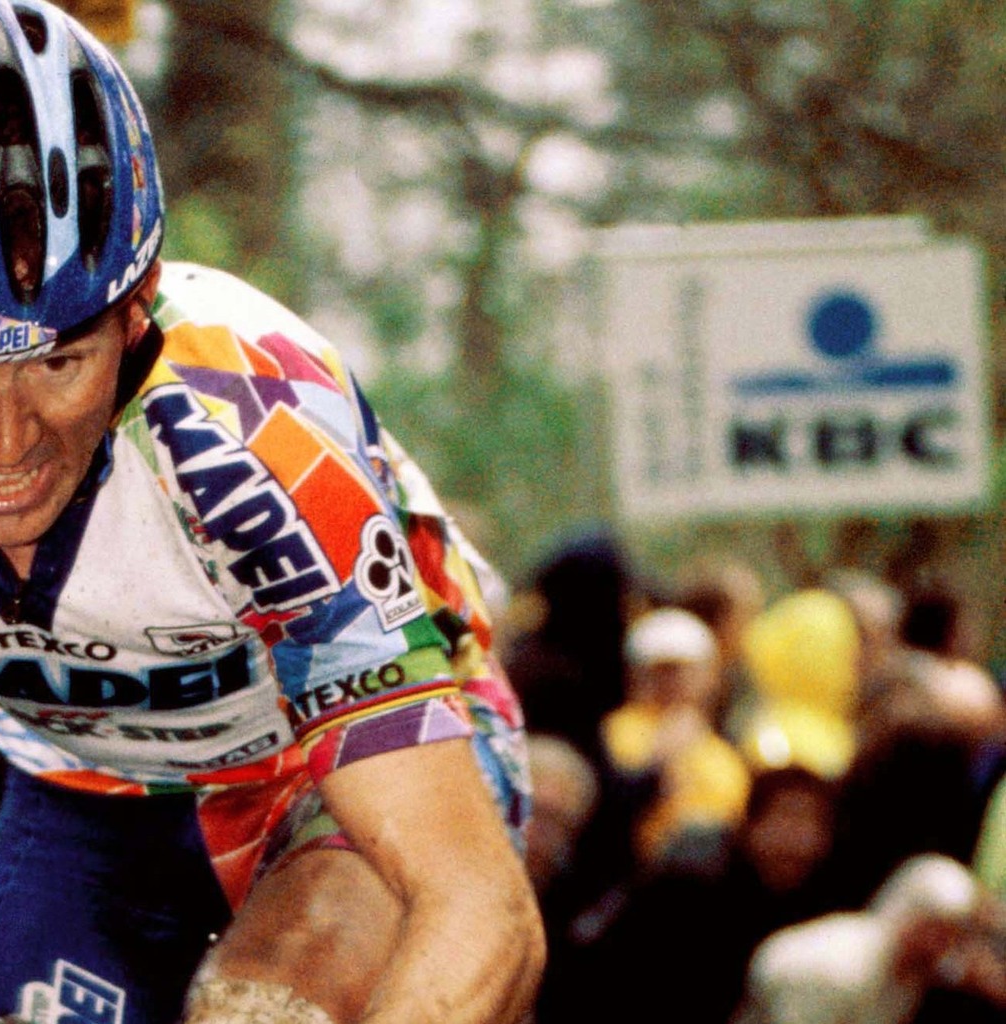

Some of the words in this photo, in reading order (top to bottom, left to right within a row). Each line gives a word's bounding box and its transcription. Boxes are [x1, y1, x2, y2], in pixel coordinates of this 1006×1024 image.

[729, 407, 962, 473] KBC
[143, 391, 334, 607] MAPEI
[294, 663, 406, 722] TEXCO
